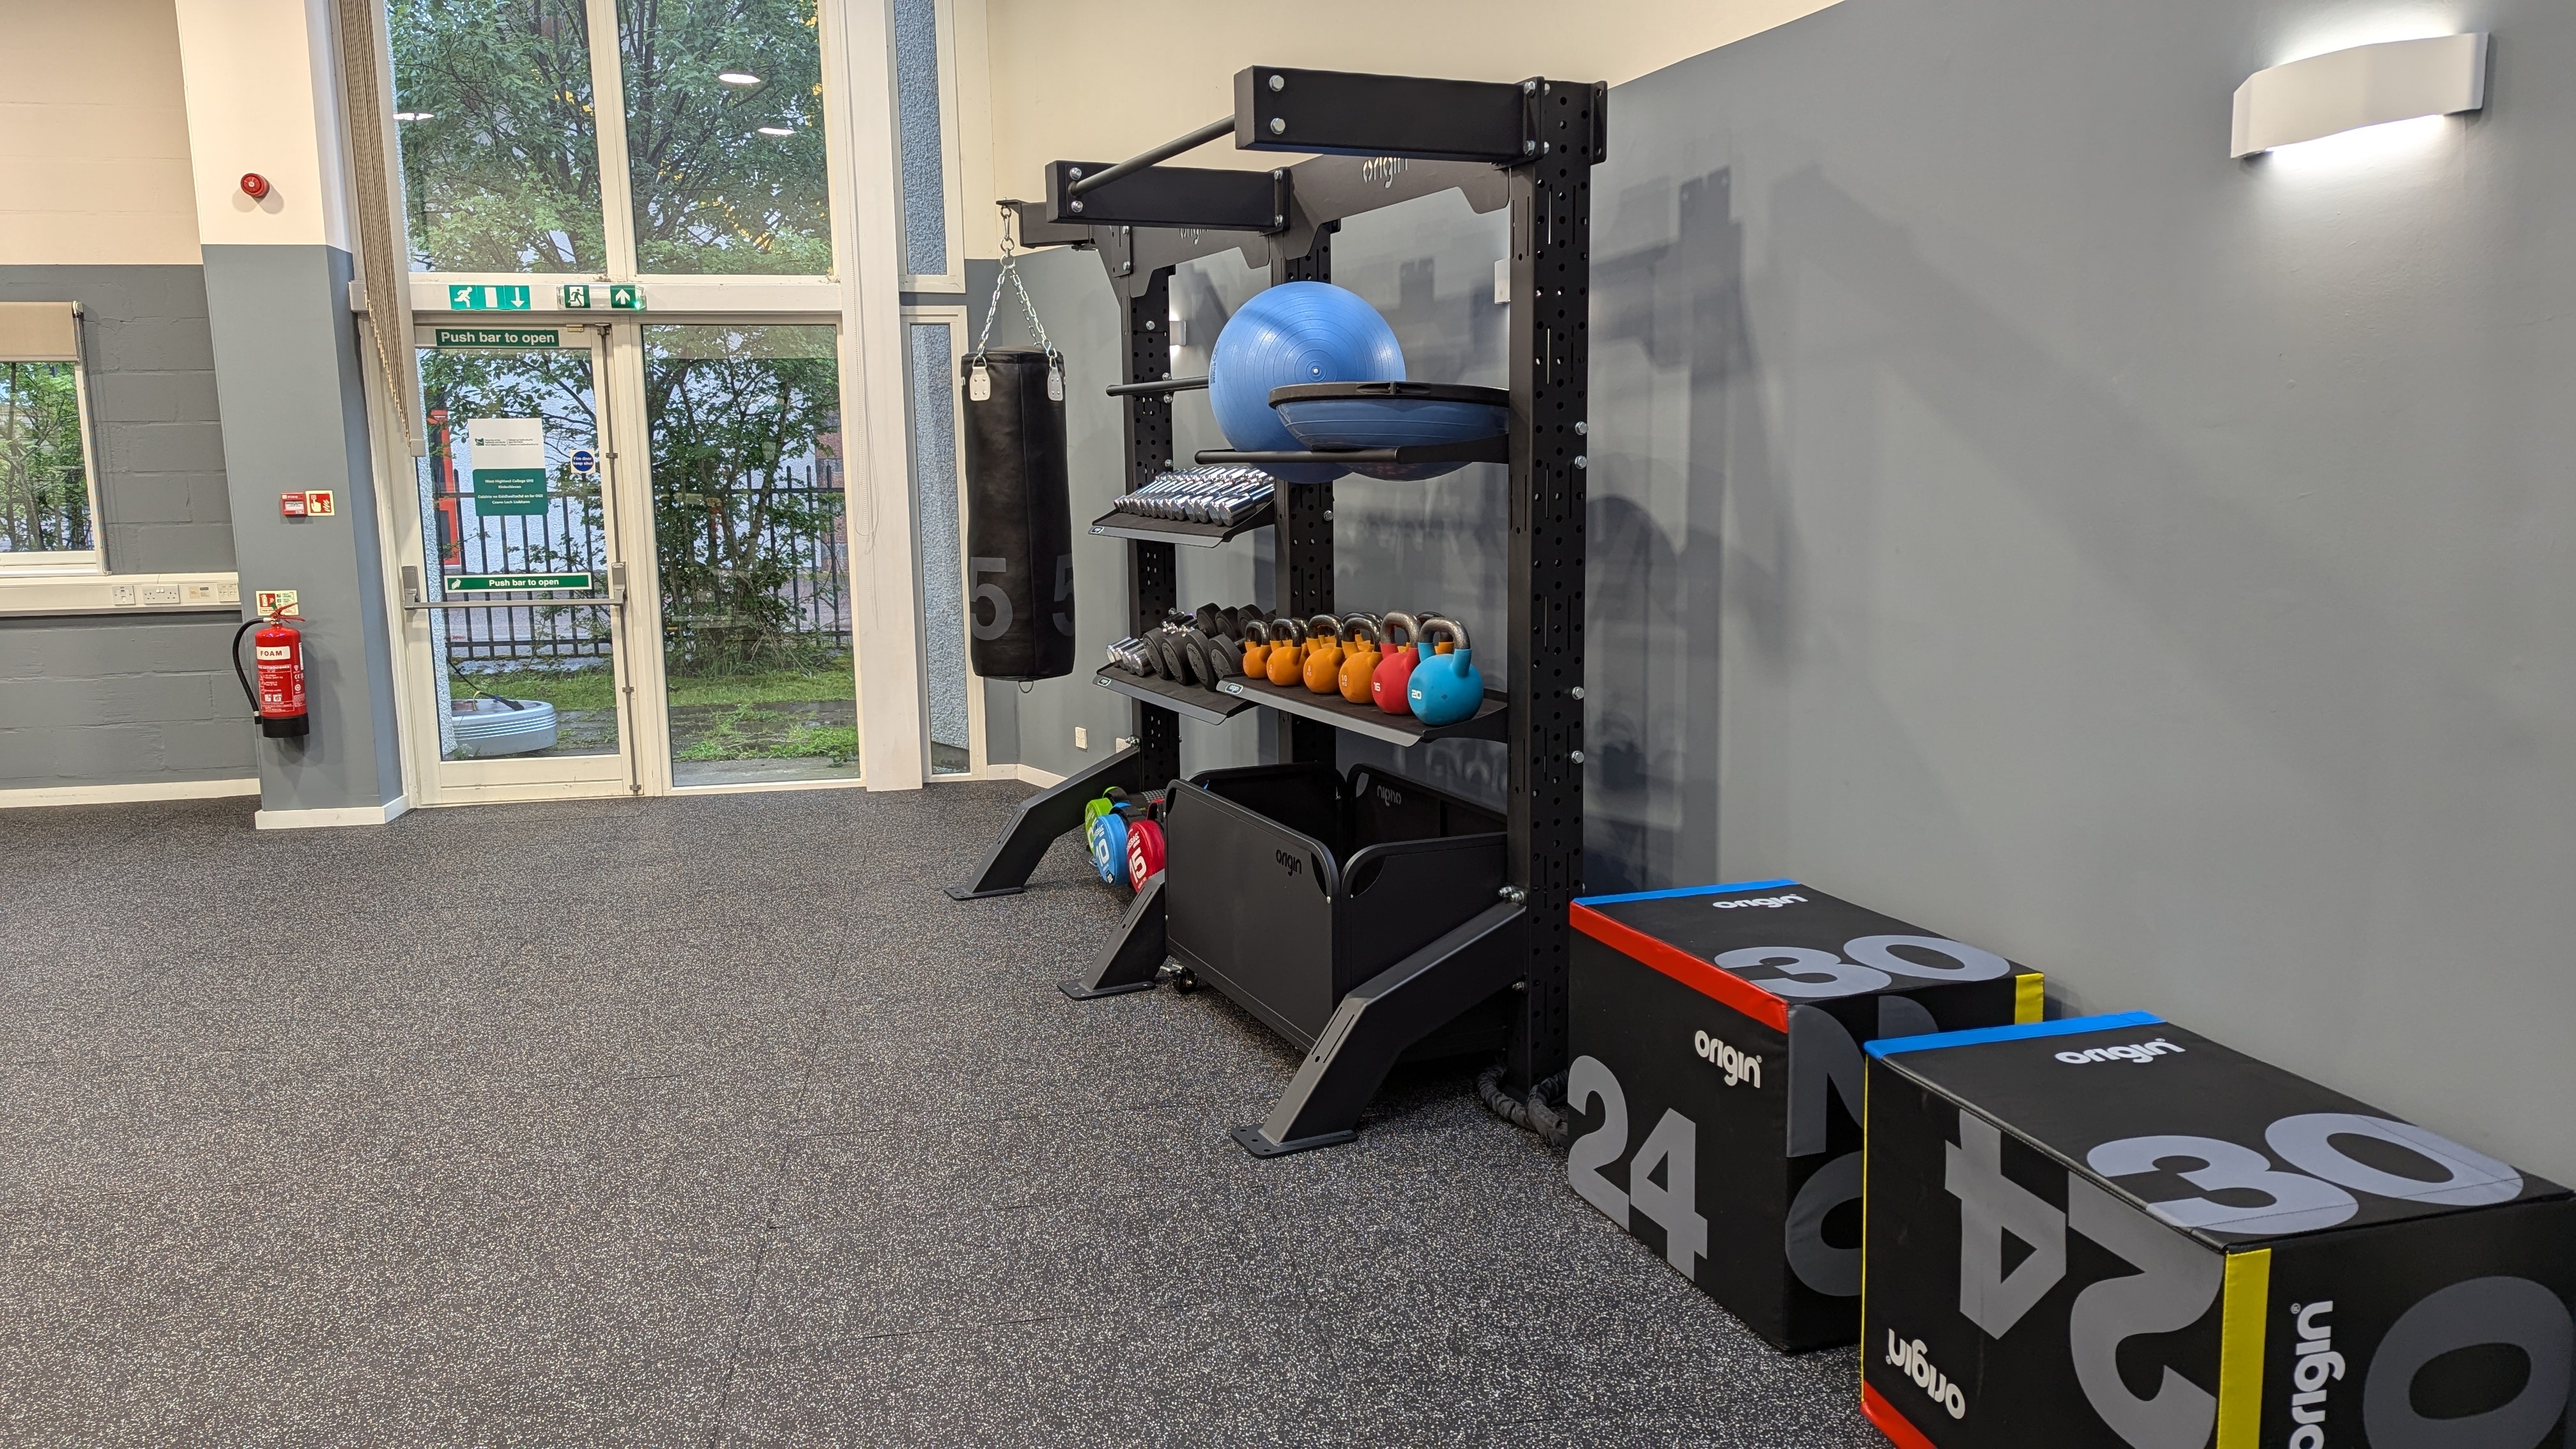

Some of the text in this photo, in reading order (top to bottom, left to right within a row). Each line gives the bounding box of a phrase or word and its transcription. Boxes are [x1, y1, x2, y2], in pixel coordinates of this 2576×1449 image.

[1179, 228, 1209, 245] orig
[441, 332, 555, 345] Push bar to open
[970, 556, 1013, 641] 5
[1374, 682, 1381, 692] 16
[1411, 689, 1422, 700] 20
[1096, 838, 1110, 867] 10
[1129, 847, 1147, 884] 15
[1276, 849, 1302, 877] origin
[1712, 893, 1807, 910] origin
[1715, 935, 2011, 998] 30
[1694, 1029, 1761, 1089] origin
[2054, 1037, 2186, 1064] origin
[1567, 1055, 1708, 1282] 24
[2086, 1112, 2524, 1235] 30
[1944, 1107, 2226, 1449] 24
[1886, 1328, 1966, 1420] origin
